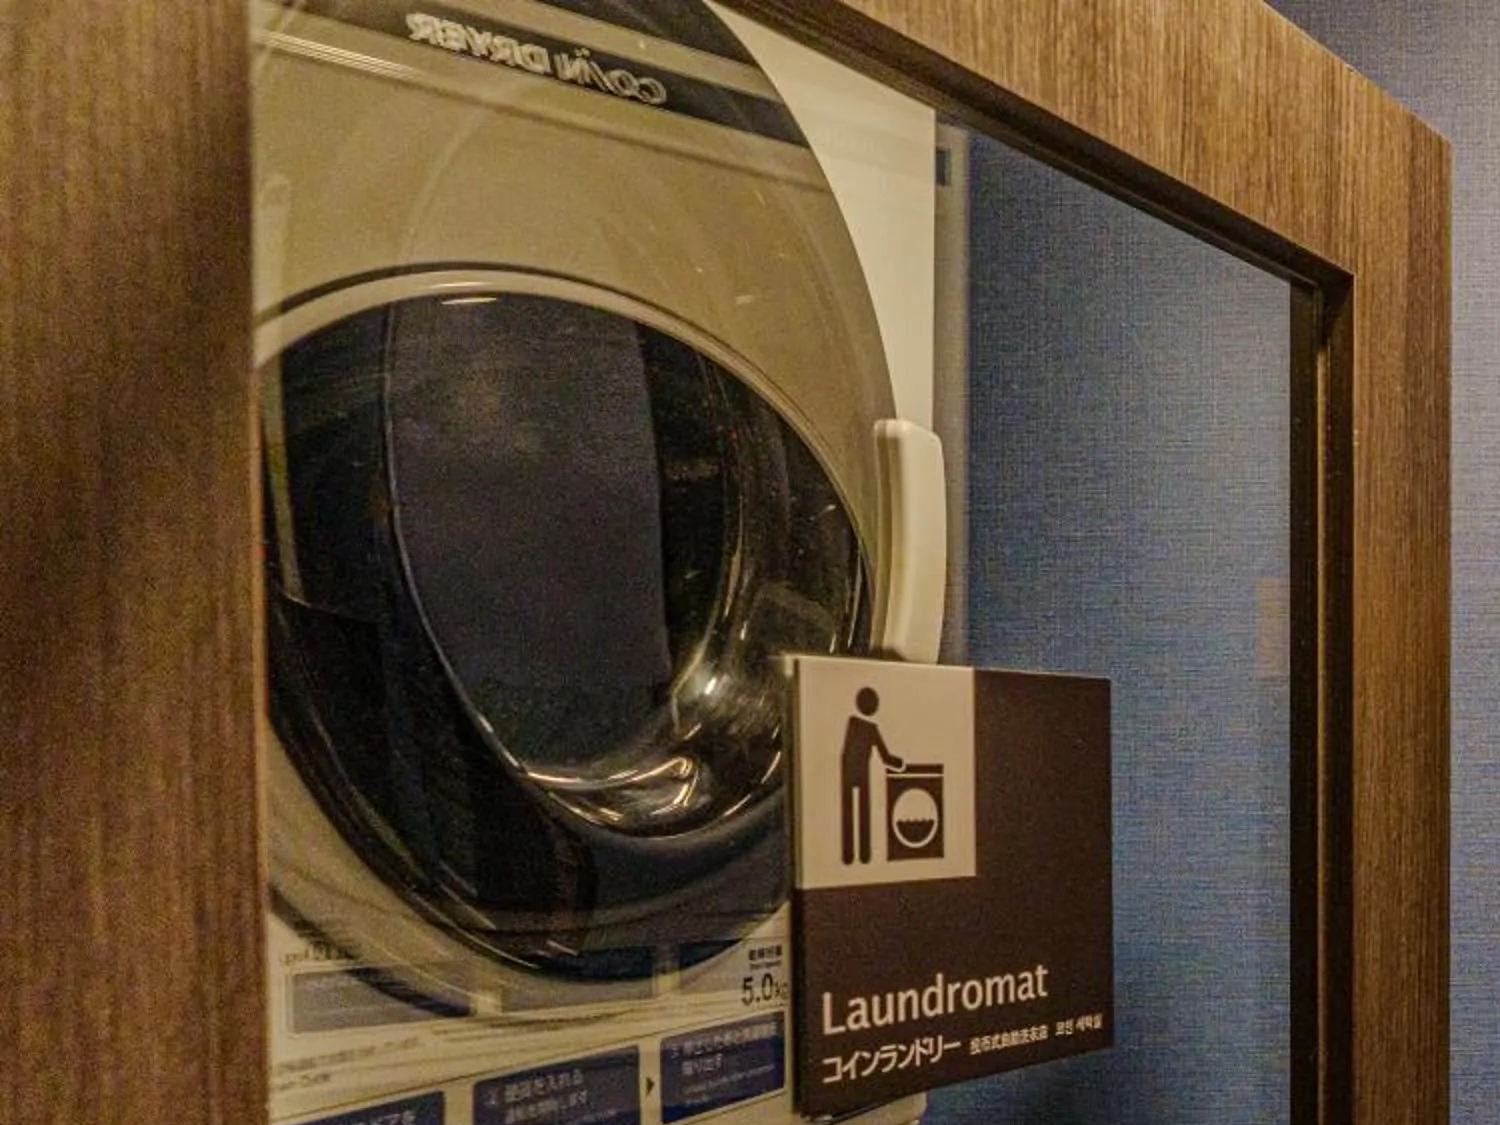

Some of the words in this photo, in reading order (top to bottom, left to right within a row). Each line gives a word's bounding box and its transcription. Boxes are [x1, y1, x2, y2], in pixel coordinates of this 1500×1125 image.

[822, 964, 1049, 1035] Laundromat
[823, 1035, 960, 1084] コインランドリー
